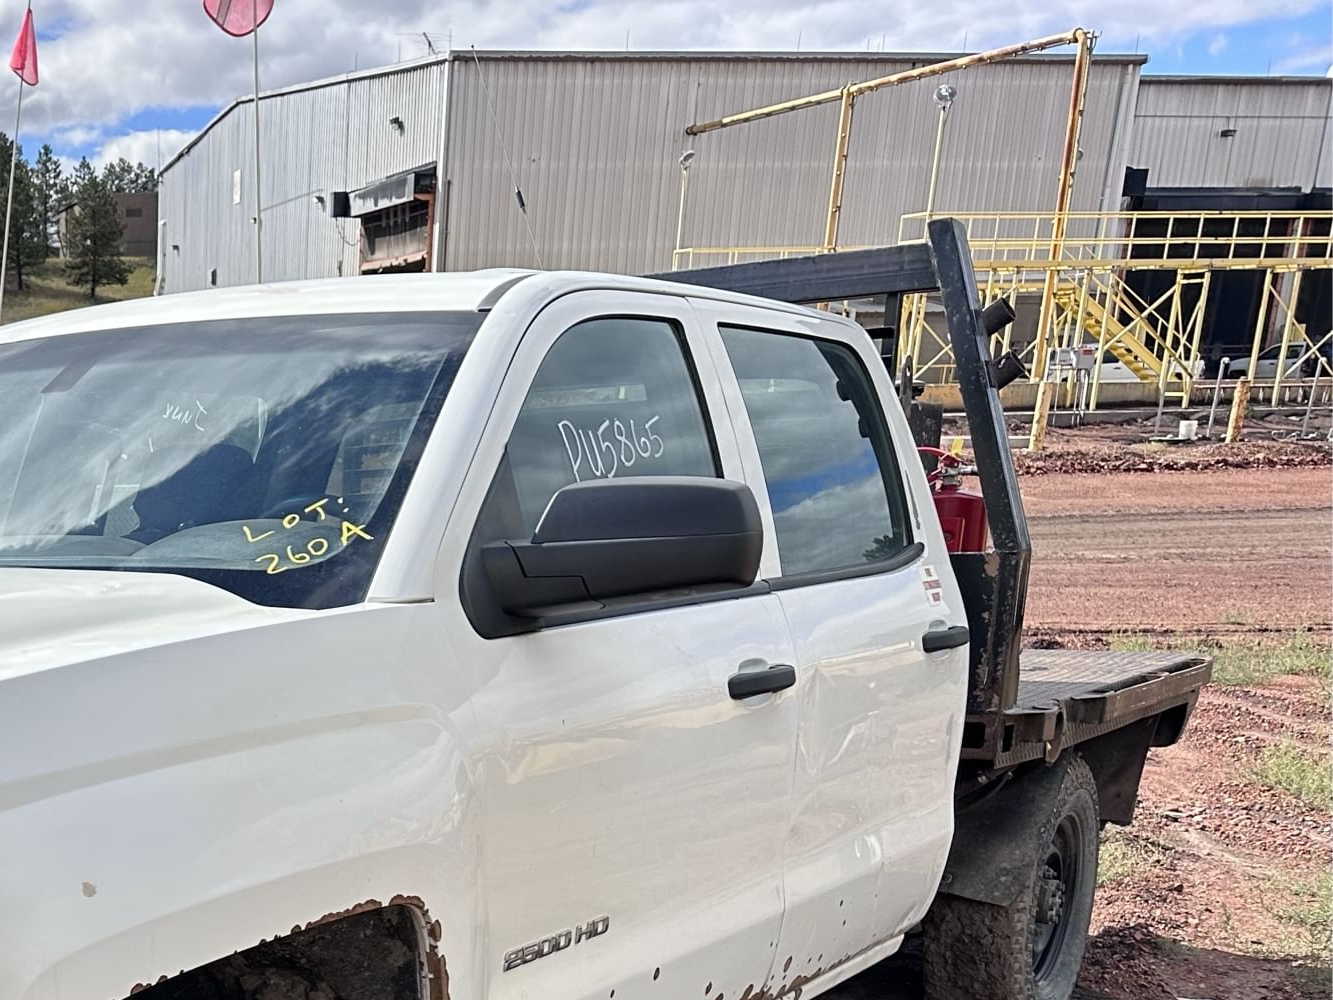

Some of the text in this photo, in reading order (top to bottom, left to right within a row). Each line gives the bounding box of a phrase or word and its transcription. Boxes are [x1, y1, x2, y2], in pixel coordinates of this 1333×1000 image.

[242, 497, 351, 543] LOT:
[502, 912, 610, 973] 2500 HD
